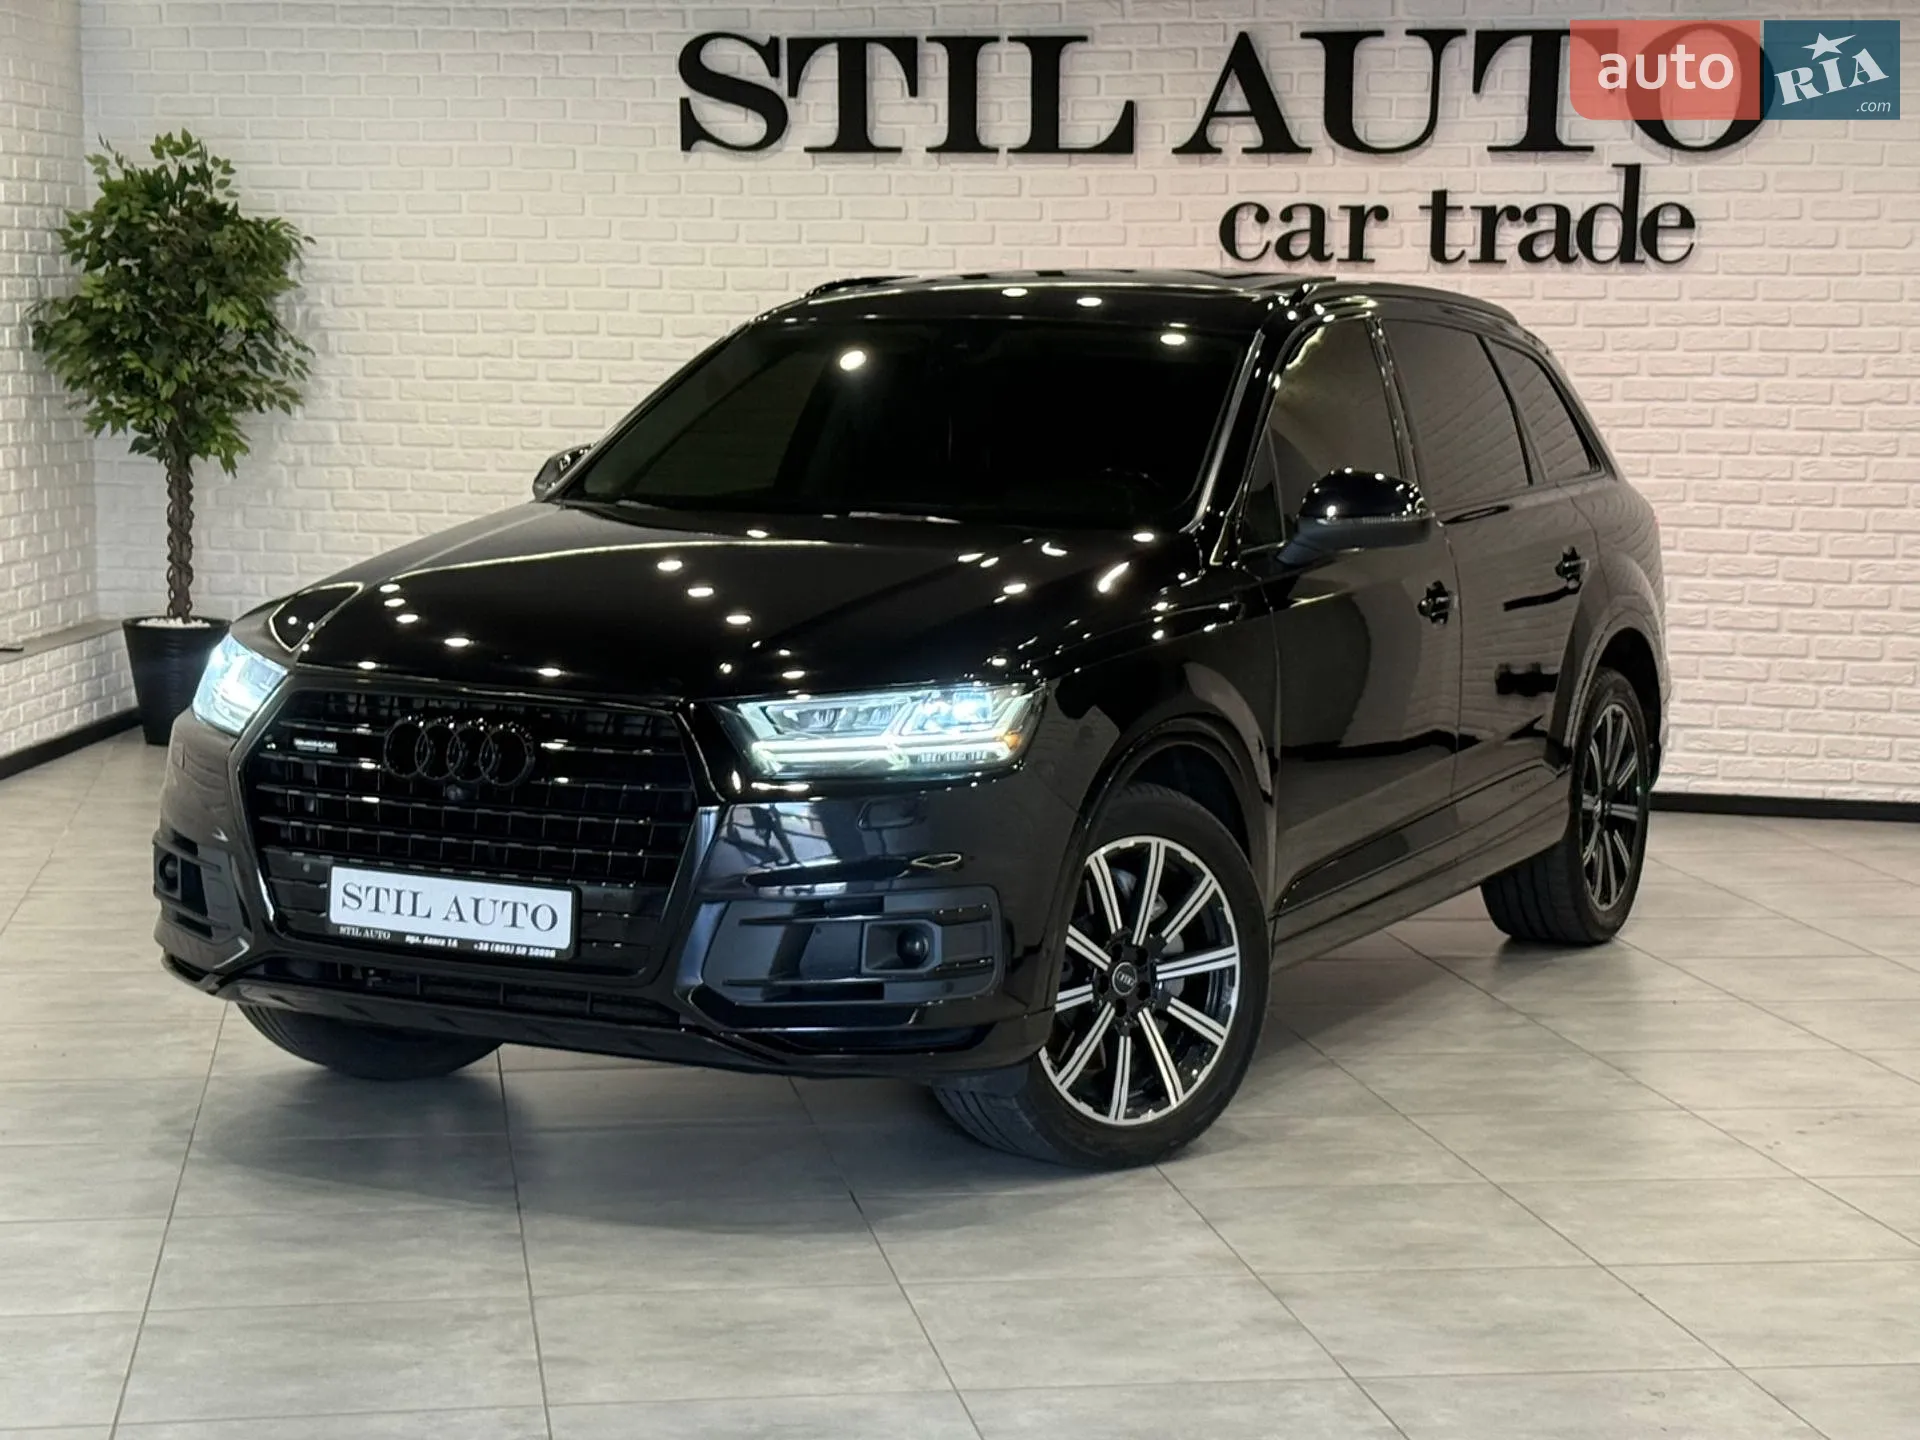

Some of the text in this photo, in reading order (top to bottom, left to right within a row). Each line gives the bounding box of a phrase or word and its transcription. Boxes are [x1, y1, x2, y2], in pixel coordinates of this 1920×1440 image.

[678, 22, 1775, 155] STIL AUTO
[1218, 162, 1696, 265] car trade
[341, 881, 559, 933] STIL AUTO
[363, 928, 391, 941] AUTO
